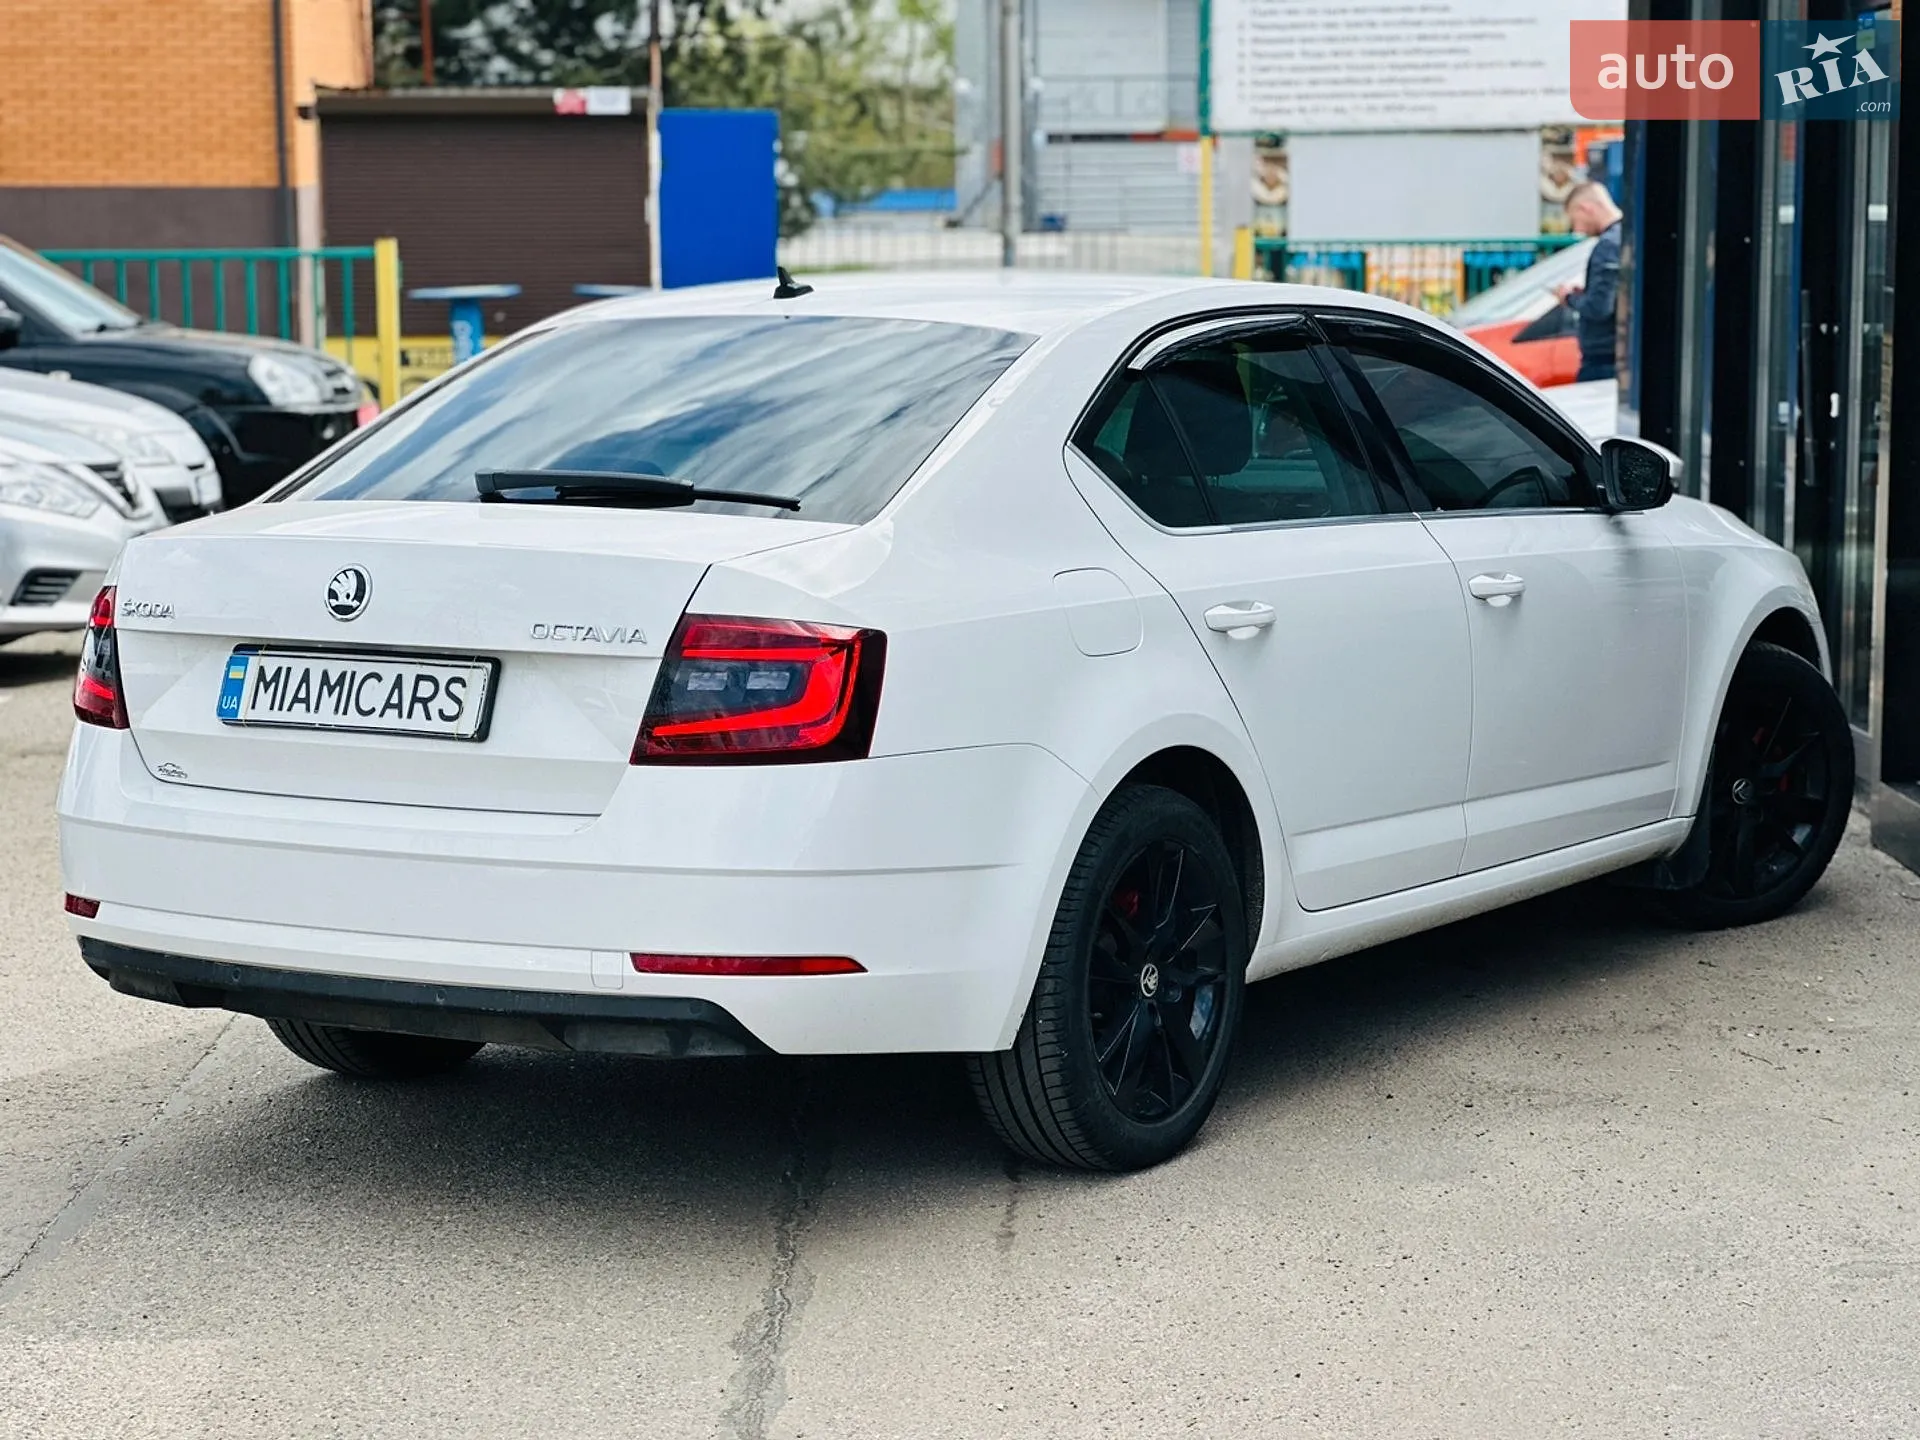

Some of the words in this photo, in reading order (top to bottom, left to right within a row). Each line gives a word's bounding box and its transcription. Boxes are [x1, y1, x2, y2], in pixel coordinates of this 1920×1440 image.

[531, 623, 648, 645] OCTAVIA
[221, 696, 239, 710] UA
[250, 665, 467, 722] MIAMICARS
